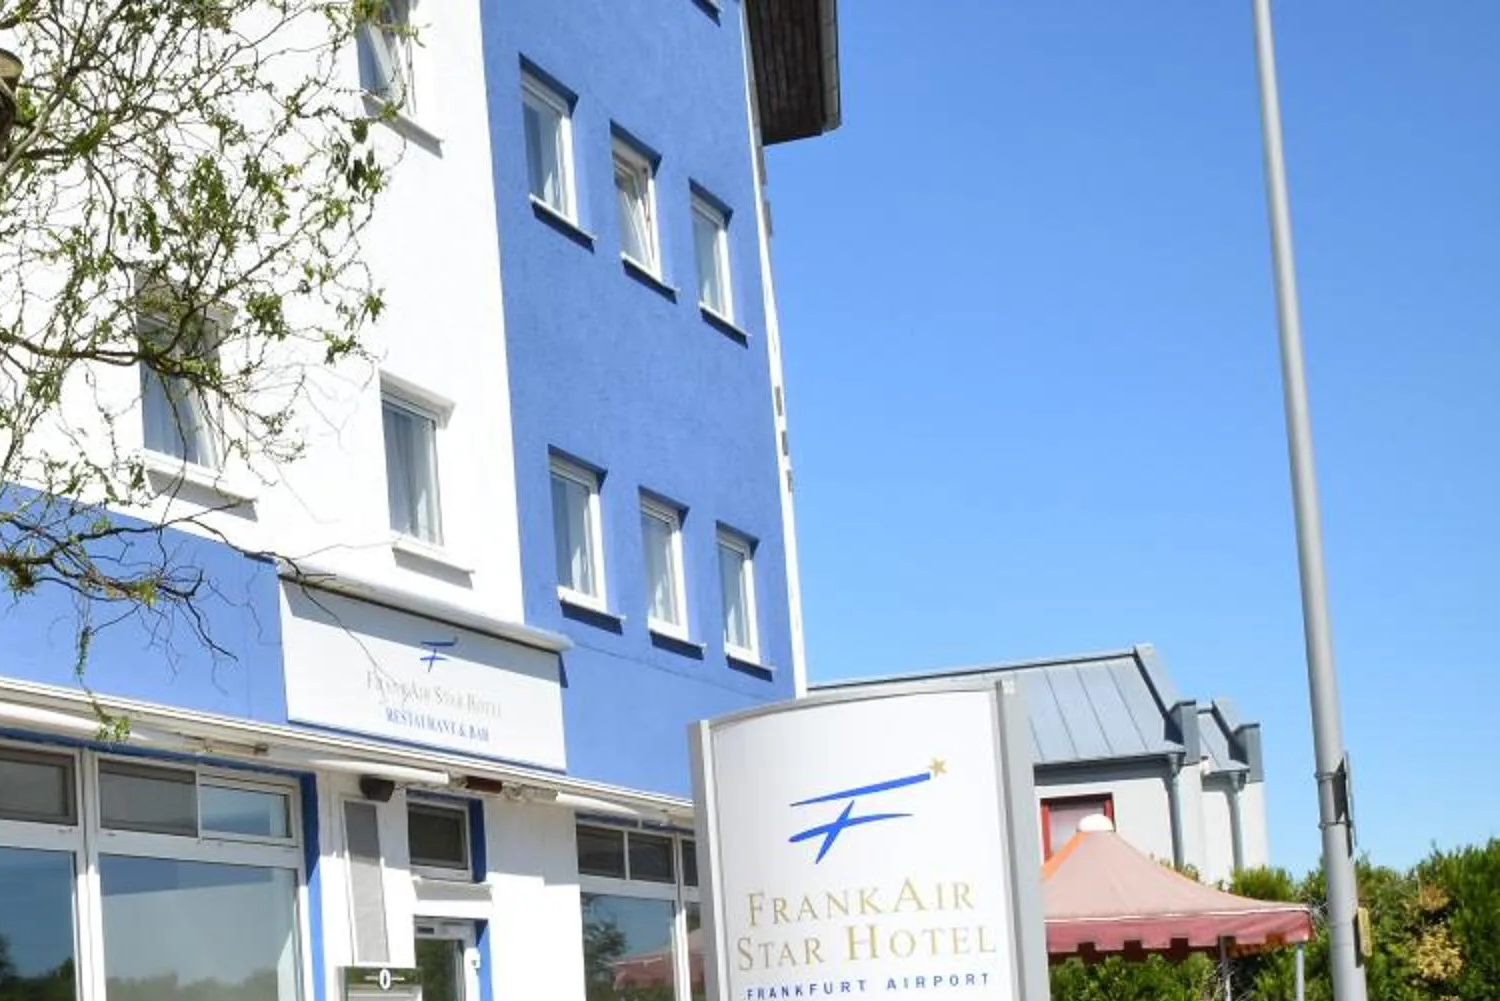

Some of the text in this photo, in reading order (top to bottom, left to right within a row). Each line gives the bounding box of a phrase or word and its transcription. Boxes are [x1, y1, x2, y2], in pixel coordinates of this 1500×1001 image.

[386, 706, 489, 742] RESTAURANT & BAR
[747, 876, 975, 928] FRANKAIR
[737, 922, 997, 972] STAR HOTEL
[746, 972, 990, 1001] FRANKFURT AIRPORT
